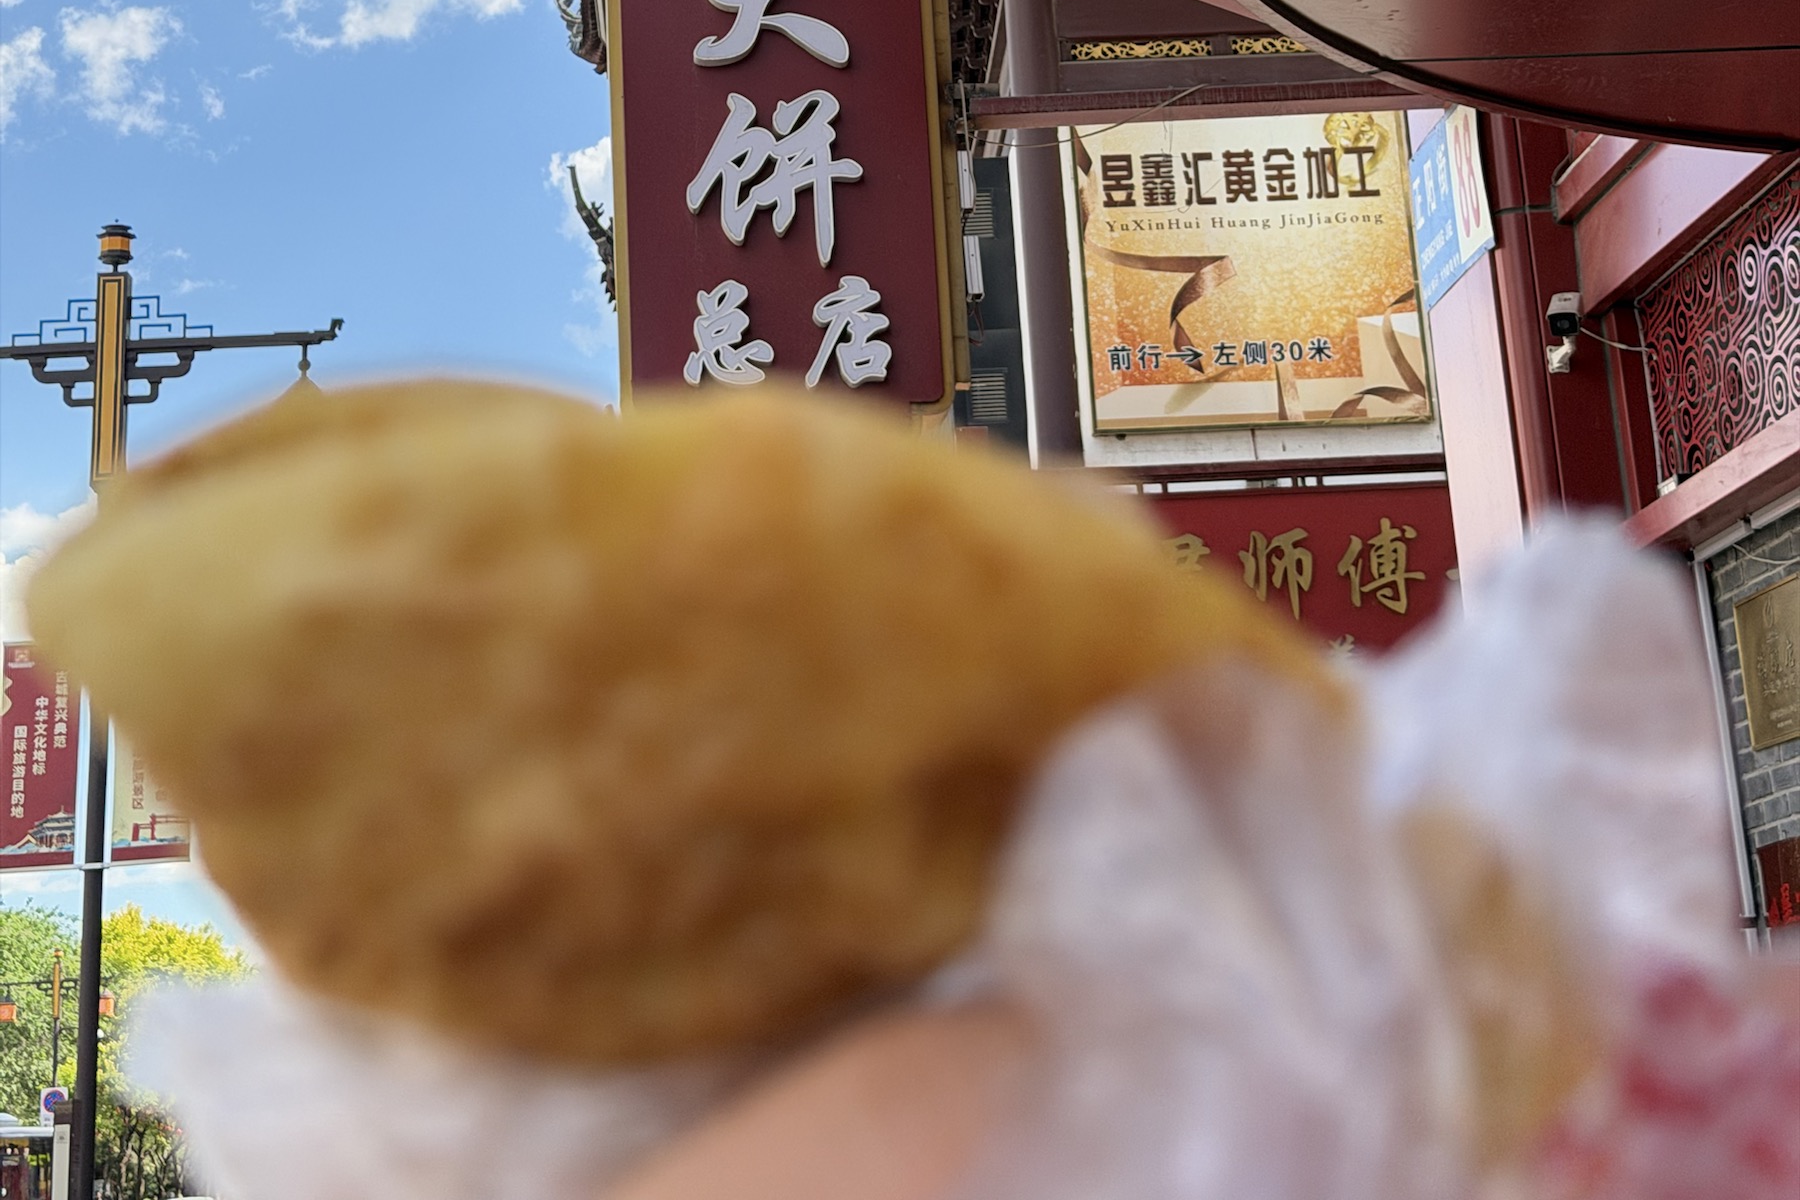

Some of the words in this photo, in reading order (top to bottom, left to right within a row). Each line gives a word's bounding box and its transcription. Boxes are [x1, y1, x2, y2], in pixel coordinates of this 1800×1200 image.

[1100, 145, 1381, 209] 昱鑫汇黄金加工
[1454, 113, 1481, 239] 88
[1105, 216, 1201, 233] YuXinHui
[1211, 214, 1272, 230] Huang
[1279, 211, 1385, 229] JinJiaGong
[683, 274, 892, 389] 总店
[1106, 343, 1163, 372] 前行
[1212, 336, 1334, 367] 左侧30米
[11, 726, 28, 818] 国际旅游目的地
[33, 696, 49, 775] 中华文化地标
